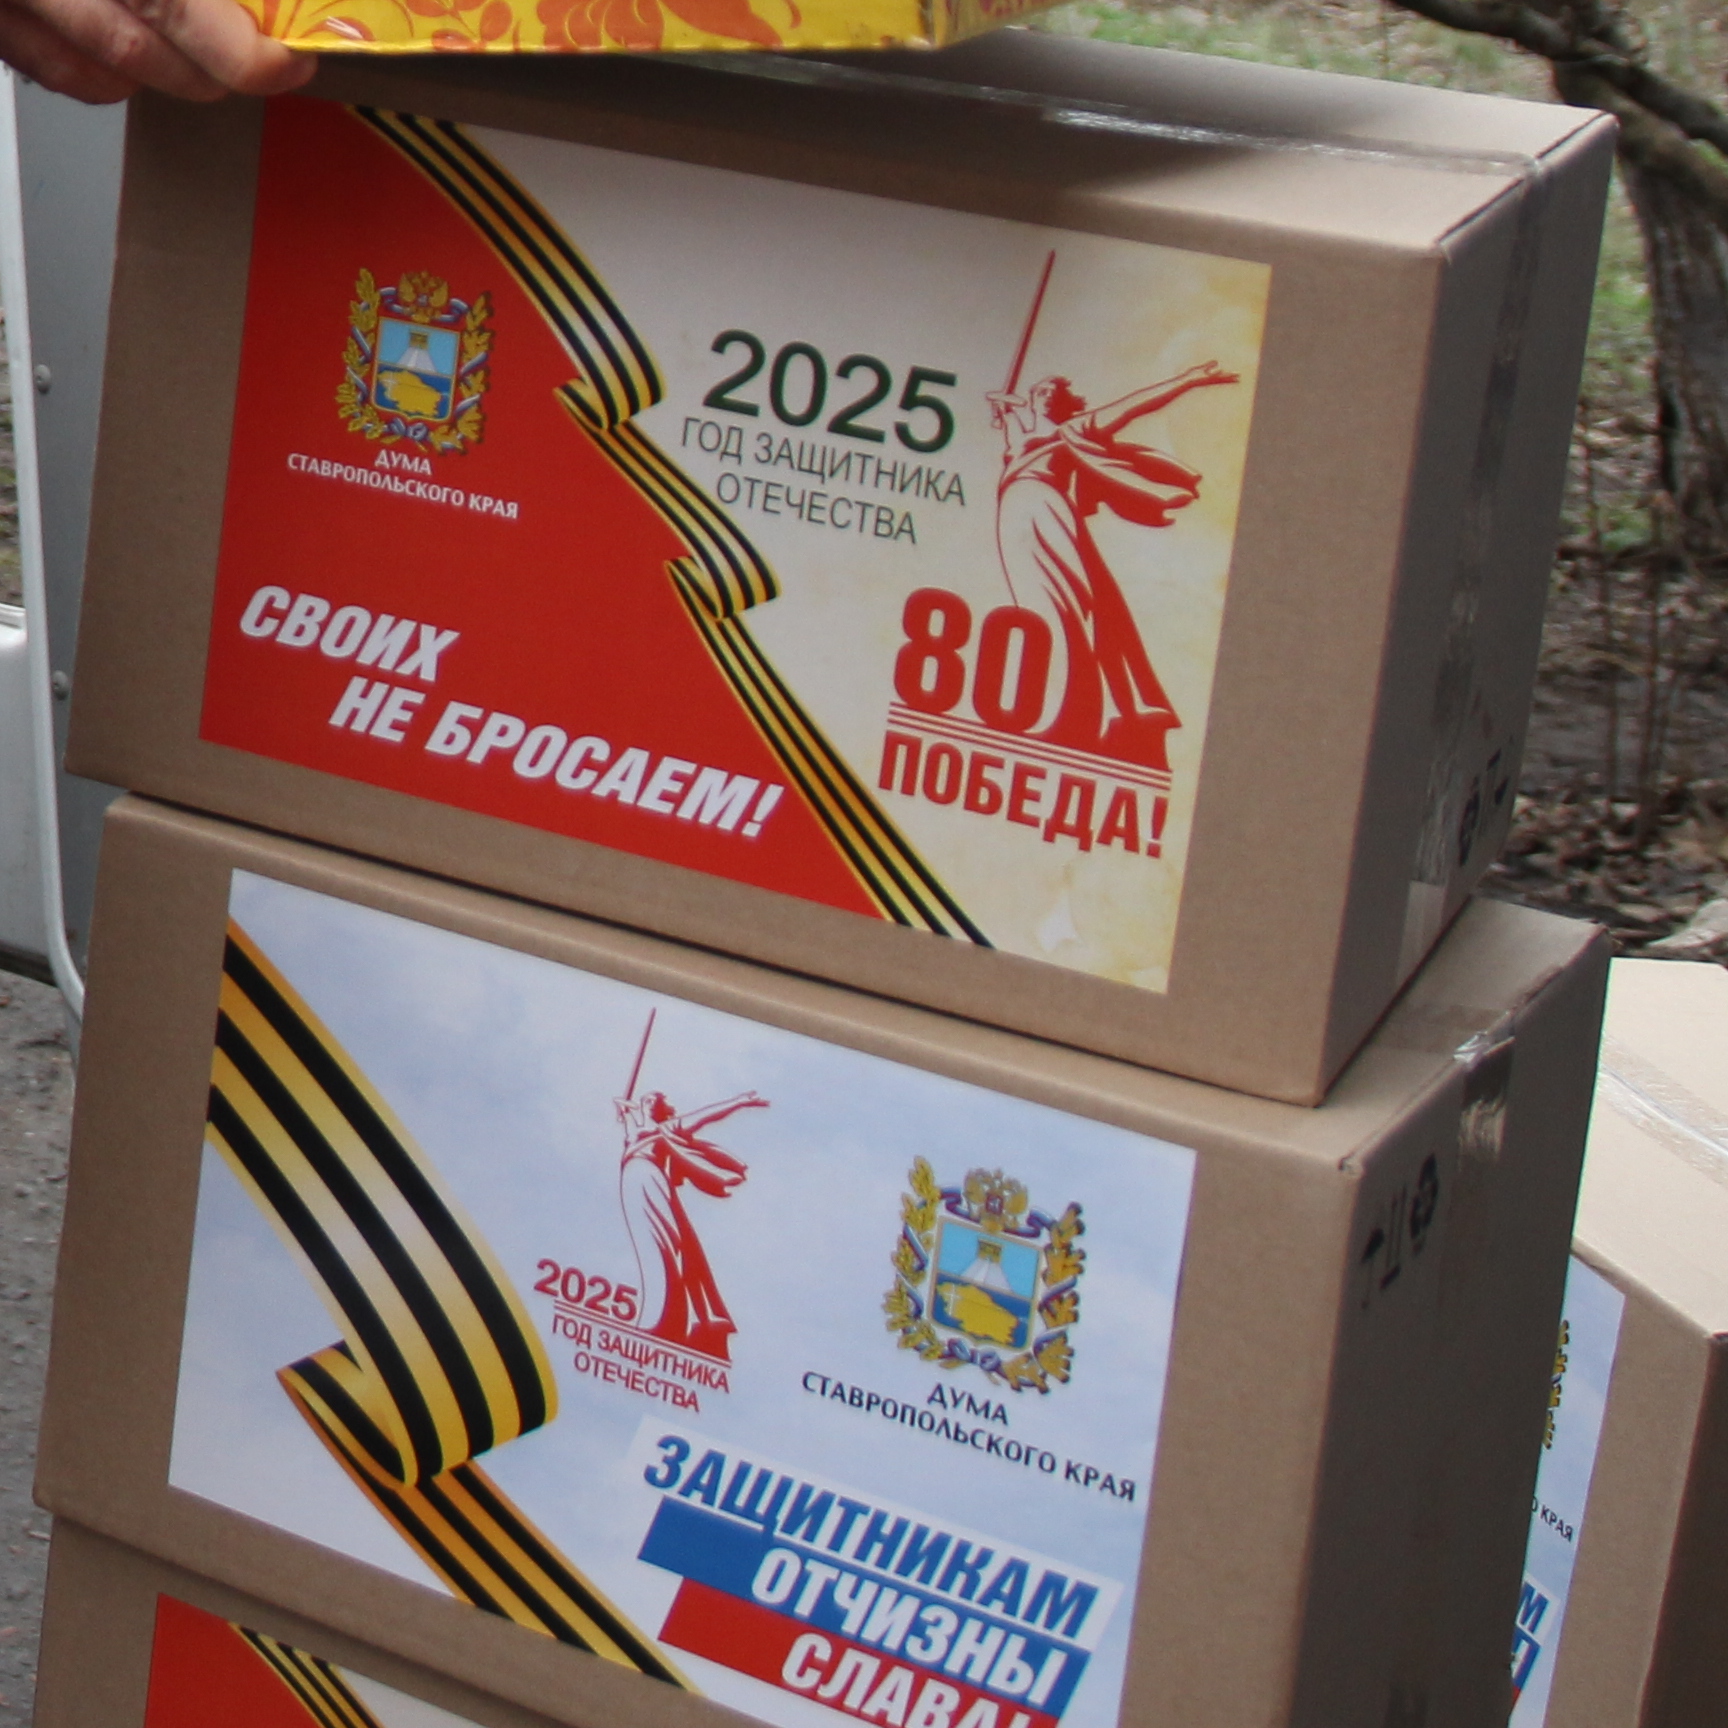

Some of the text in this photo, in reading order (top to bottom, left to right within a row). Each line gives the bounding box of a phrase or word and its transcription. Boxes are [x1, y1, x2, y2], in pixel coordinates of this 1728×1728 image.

[702, 329, 957, 453] 2025
[287, 453, 519, 519] СТАВРОПОЛЬСКОГО КРАЯ
[374, 448, 432, 475] ДУМА
[682, 417, 965, 506] ГОД ЗАЩИТНИКА
[717, 473, 917, 545] ОТЕЧЕСТВА
[240, 585, 459, 682] СВОИХ
[894, 587, 1053, 733] 80
[329, 676, 784, 838] НЕ БРОСАЕМ!
[878, 731, 1168, 858] ПОБЕДА!
[534, 1258, 638, 1322] 2025
[552, 1314, 730, 1394] ГОД ЗАЩИТНИКА
[574, 1352, 699, 1412] ОТЕЧЕСТВА
[802, 1370, 1136, 1502] СТАВРОПОЛЬСКОГО КРАЯ
[927, 1383, 1009, 1426] ДУМА
[642, 1434, 1099, 1640] ЗАЩИТНИКАМ
[1540, 1504, 1574, 1543] КРАЯ
[751, 1547, 1068, 1710] ОТЧИЗНЫ
[781, 1631, 1031, 1728] СЛАВ
